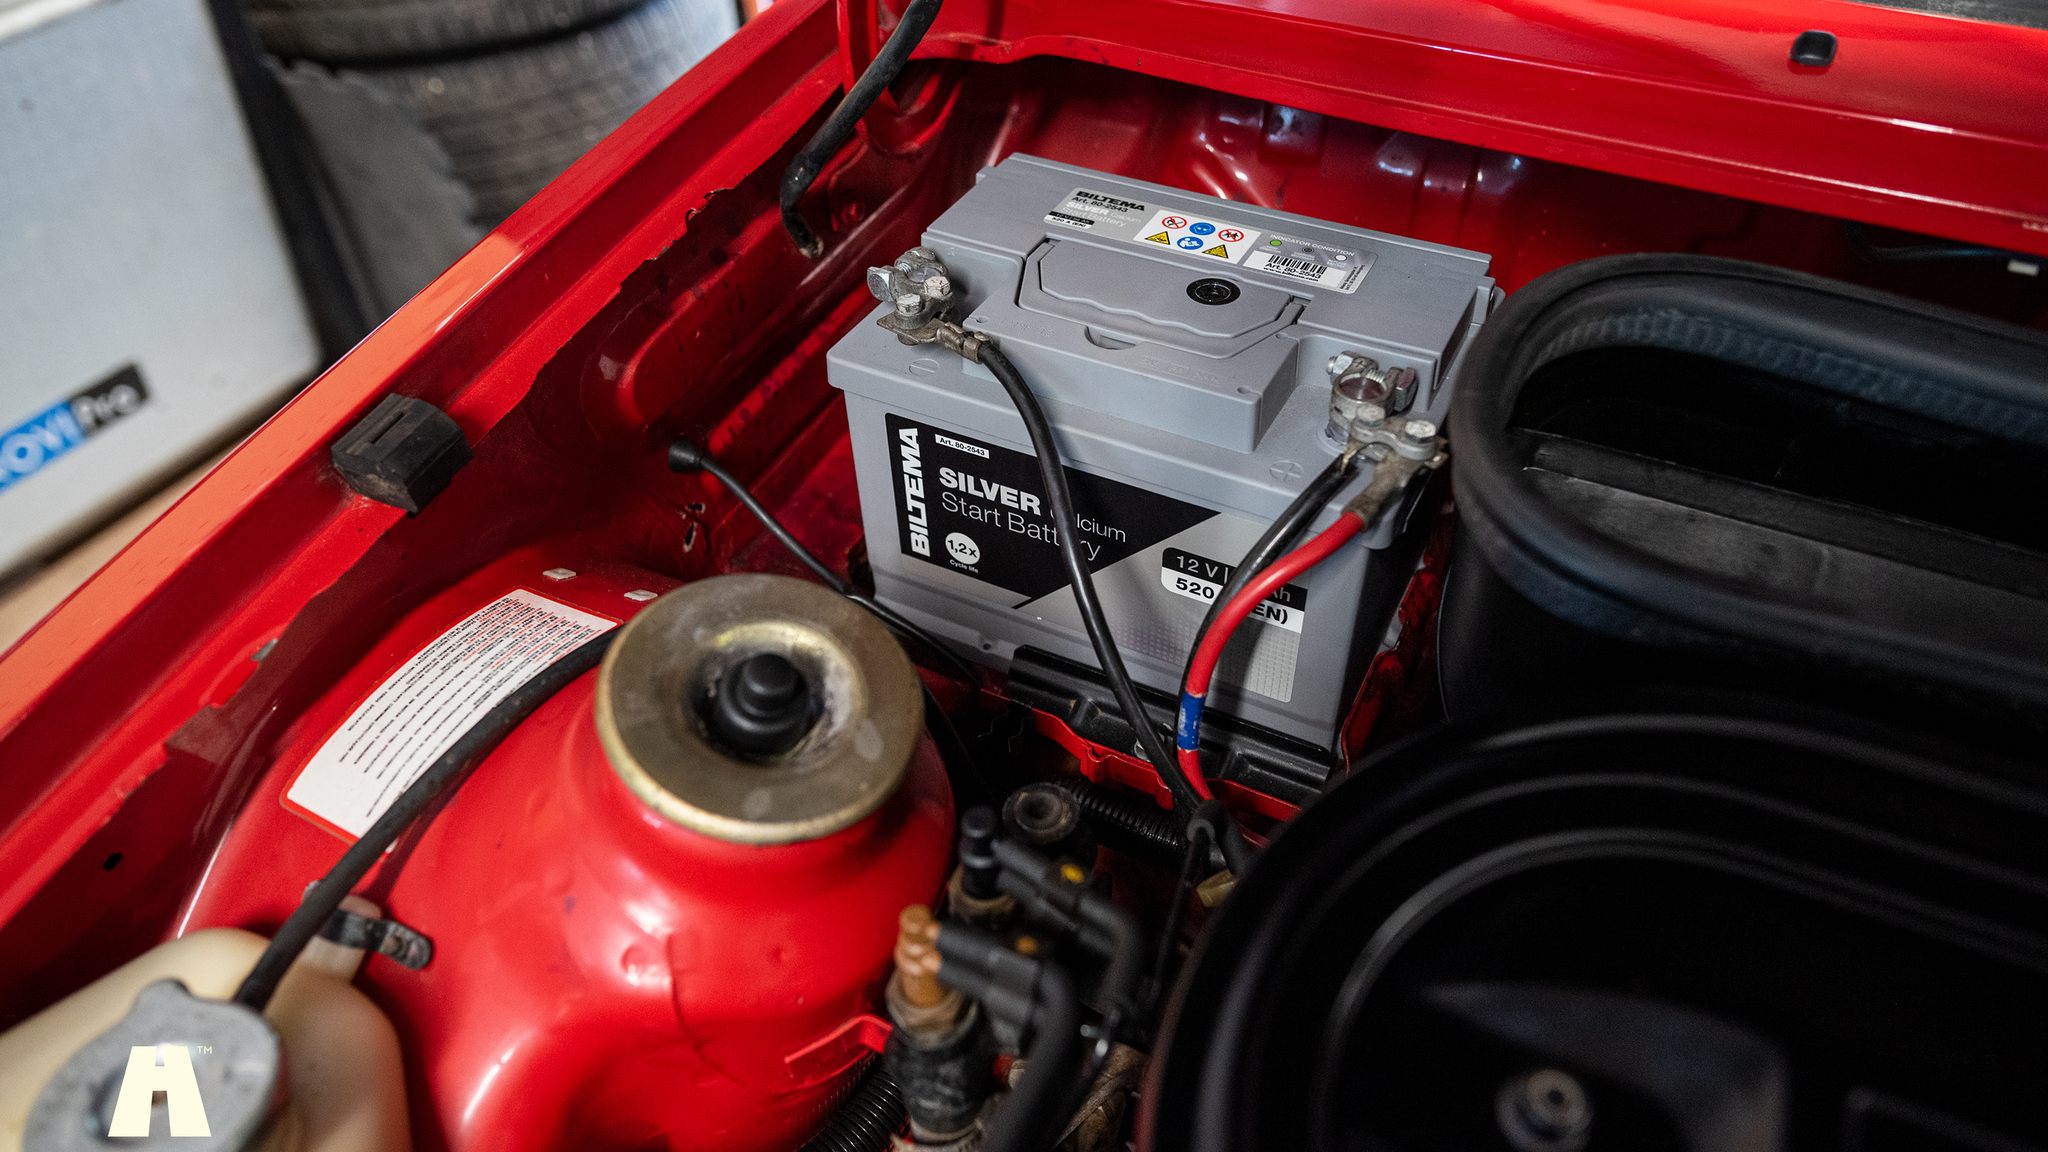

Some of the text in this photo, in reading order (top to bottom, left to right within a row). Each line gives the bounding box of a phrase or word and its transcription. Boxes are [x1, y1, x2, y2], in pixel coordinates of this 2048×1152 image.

[1066, 201, 1109, 216] SILVER
[1072, 197, 1128, 213] Art. 80-2543
[1076, 191, 1145, 211] BILTEMA
[1060, 206, 1127, 228] Start Battery
[1269, 234, 1311, 246] INDICATOR
[1312, 243, 1355, 256] CONDITION
[1265, 263, 1322, 279] Art. 80-2543
[939, 437, 985, 456] Art. 80-2543
[899, 428, 930, 557] BILTEMA
[939, 467, 1127, 543] SILVER lcium
[942, 491, 1001, 528] Start
[949, 559, 979, 574] Cycle life
[1176, 555, 1199, 573] 12
[1204, 562, 1219, 578] V
[1175, 577, 1215, 599] 520
